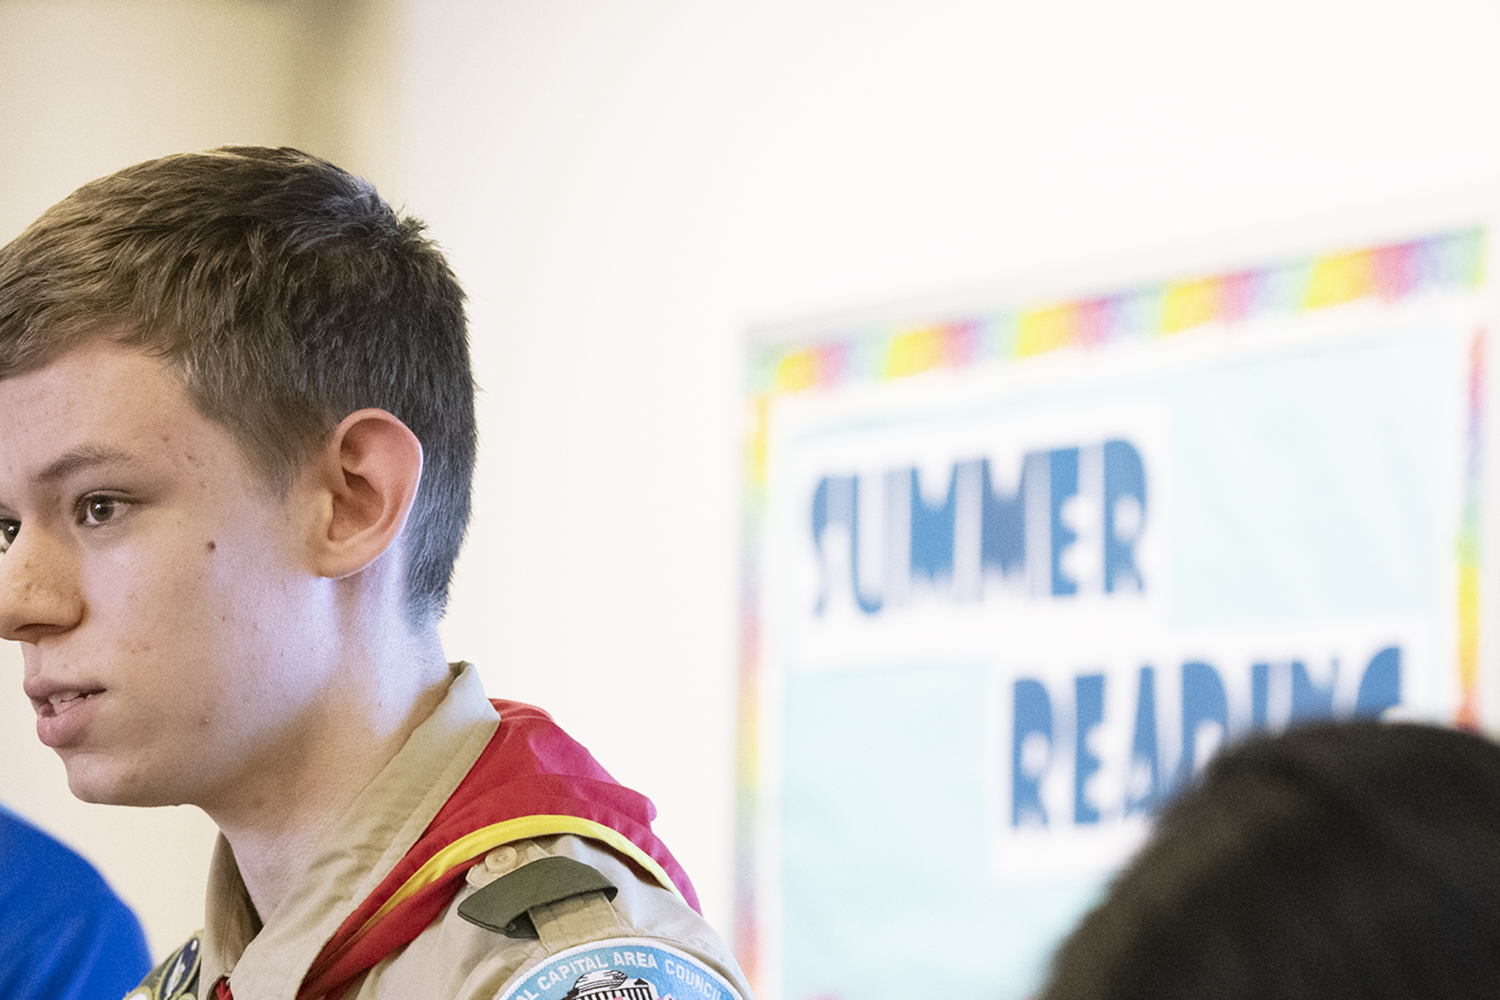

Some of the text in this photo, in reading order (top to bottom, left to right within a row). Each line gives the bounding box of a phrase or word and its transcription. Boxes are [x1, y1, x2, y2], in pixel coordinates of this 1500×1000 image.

[811, 438, 1148, 618] SUMMER
[537, 955, 609, 991] CAPITAL
[613, 951, 659, 970] AREA
